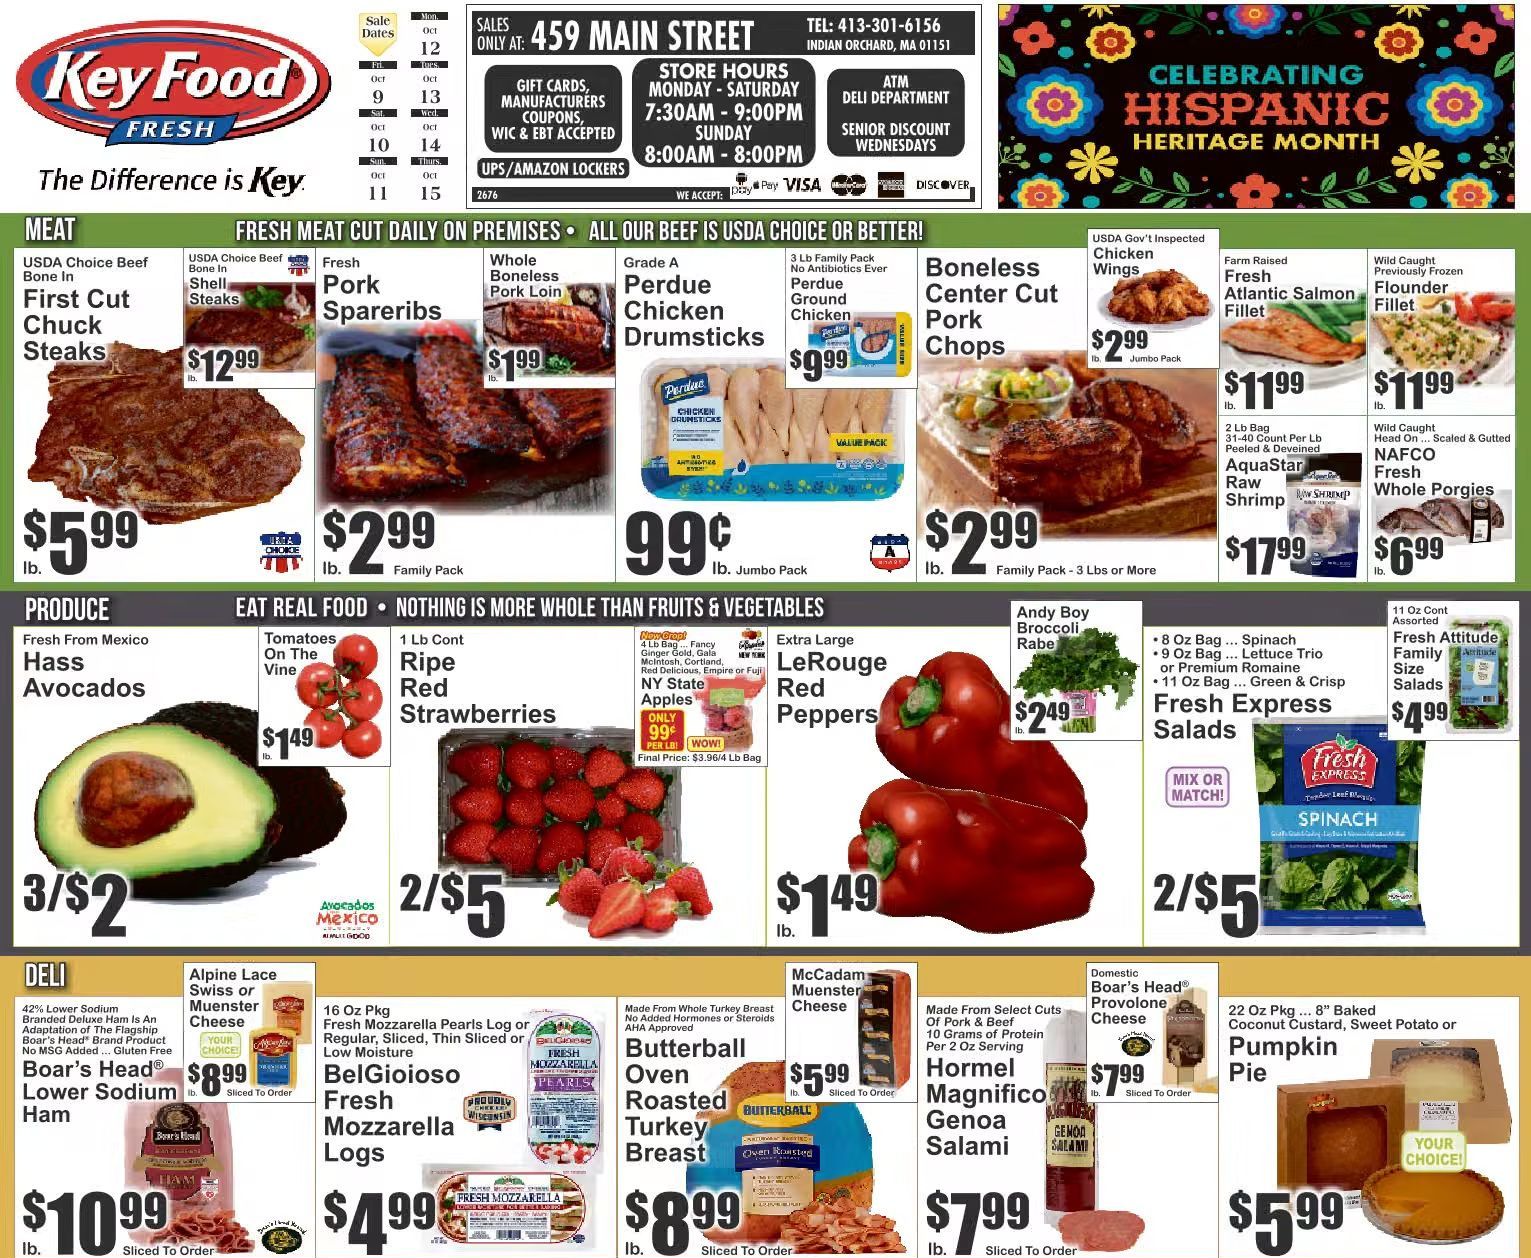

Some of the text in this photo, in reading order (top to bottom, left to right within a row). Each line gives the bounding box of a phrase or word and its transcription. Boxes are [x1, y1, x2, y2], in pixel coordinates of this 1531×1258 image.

[807, 17, 941, 33] TEL: 413-301-6156
[531, 20, 754, 51] 459 MAIN STREET
[807, 39, 950, 52] INDIAN ORCHARD, MA 01151
[659, 63, 788, 79] STORE HOURS
[1149, 64, 1363, 85] CELEBRATING
[645, 103, 714, 121] 7:30AM
[734, 103, 803, 121] 9:00PM
[1124, 91, 1389, 126] HISPANIC
[126, 121, 215, 138] FRESH
[1134, 133, 1379, 150] HERITAGE MONTH
[39, 168, 83, 190] The
[91, 167, 217, 191] Difference
[224, 168, 244, 190] is
[482, 162, 625, 177] UPS/AMAZON LOCKERS
[477, 190, 498, 200] 2676
[26, 217, 76, 240] MEAT
[236, 218, 560, 240] FRESH MEAT CUT DAILY ON PREMISES
[1093, 234, 1205, 244] USDA Gov't Inspected
[791, 253, 875, 263] 3 Lb Family Pack
[926, 257, 1040, 277] Boneless
[24, 288, 130, 309] First Cut
[323, 300, 440, 324] Spareribs
[24, 315, 102, 335] Chuck
[625, 327, 764, 346] Drumsticks
[1225, 432, 1322, 443] 31-40 Count Per Lb
[1375, 447, 1435, 461] NAFCO
[26, 597, 109, 621] PRODUCE
[236, 597, 367, 617] EAT REAL FOOD
[1017, 606, 1089, 621] Andy Boy
[778, 651, 887, 675] LeRouge
[1160, 661, 1300, 673] or Premium Romaine
[23, 678, 145, 697] Avocados
[400, 703, 556, 724] Strawberries
[1154, 693, 1332, 718] Fresh Express
[638, 753, 761, 764] Final Price: $3.96/4 Lb Bag
[1298, 812, 1377, 827] SPINACH
[25, 962, 65, 987] DELI
[22, 1004, 119, 1013] 42% Lower Sodium
[625, 1004, 774, 1014] Made From Whole Turkey Breast
[1228, 1018, 1457, 1031] Coconut Custard, Sweet Potato or
[626, 1038, 745, 1058] Butterball
[1230, 1036, 1337, 1061] Pumpkin
[325, 1064, 460, 1084] BelGioioso
[927, 1057, 1014, 1077] Hormel
[22, 1083, 177, 1101] Lower Sodium
[325, 1116, 454, 1136] Mozzarella
